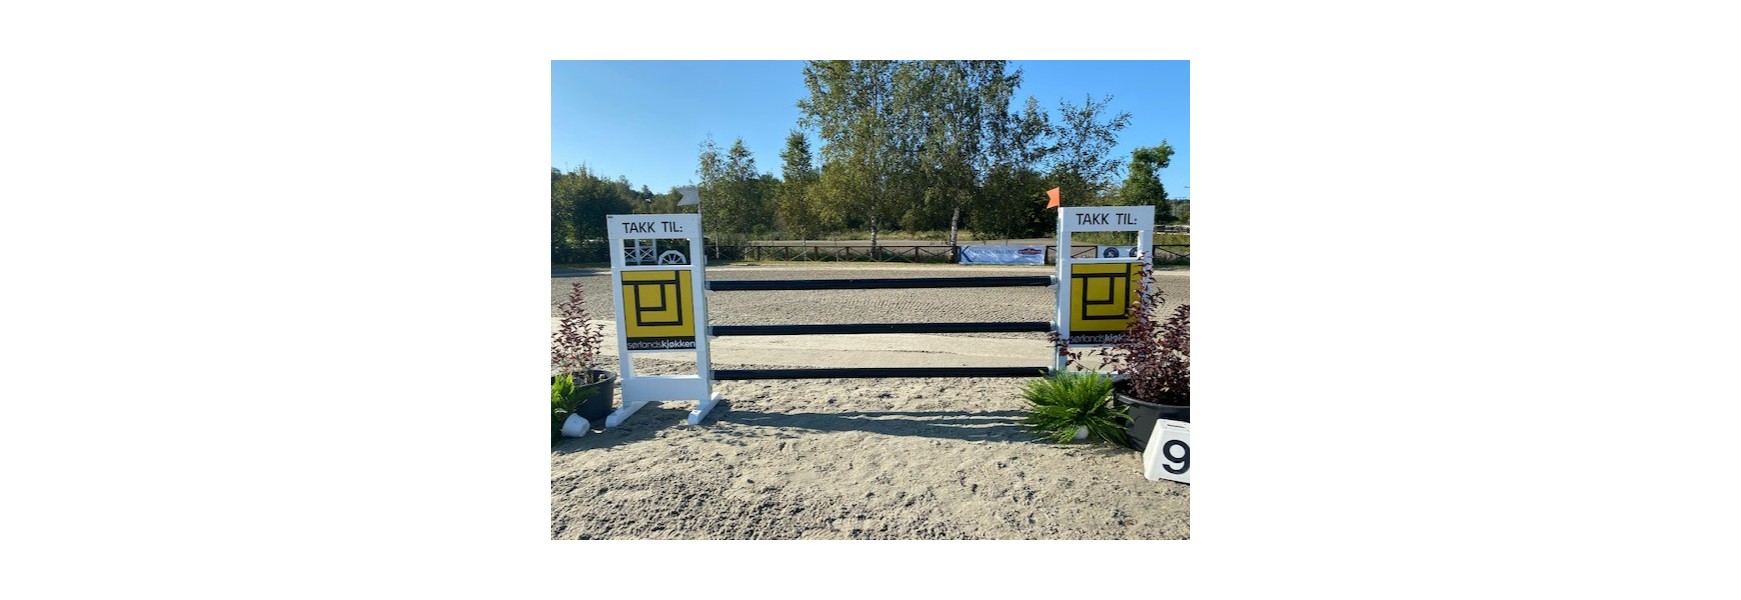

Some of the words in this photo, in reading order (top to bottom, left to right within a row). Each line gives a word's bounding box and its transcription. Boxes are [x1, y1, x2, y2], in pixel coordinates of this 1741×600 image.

[1075, 213, 1110, 225] TAKK
[1115, 213, 1138, 225] TIL:
[622, 221, 656, 233] TAKK
[661, 221, 683, 233] TIL:
[627, 340, 696, 349] sørlandskjøkken
[1162, 439, 1190, 475] 9
